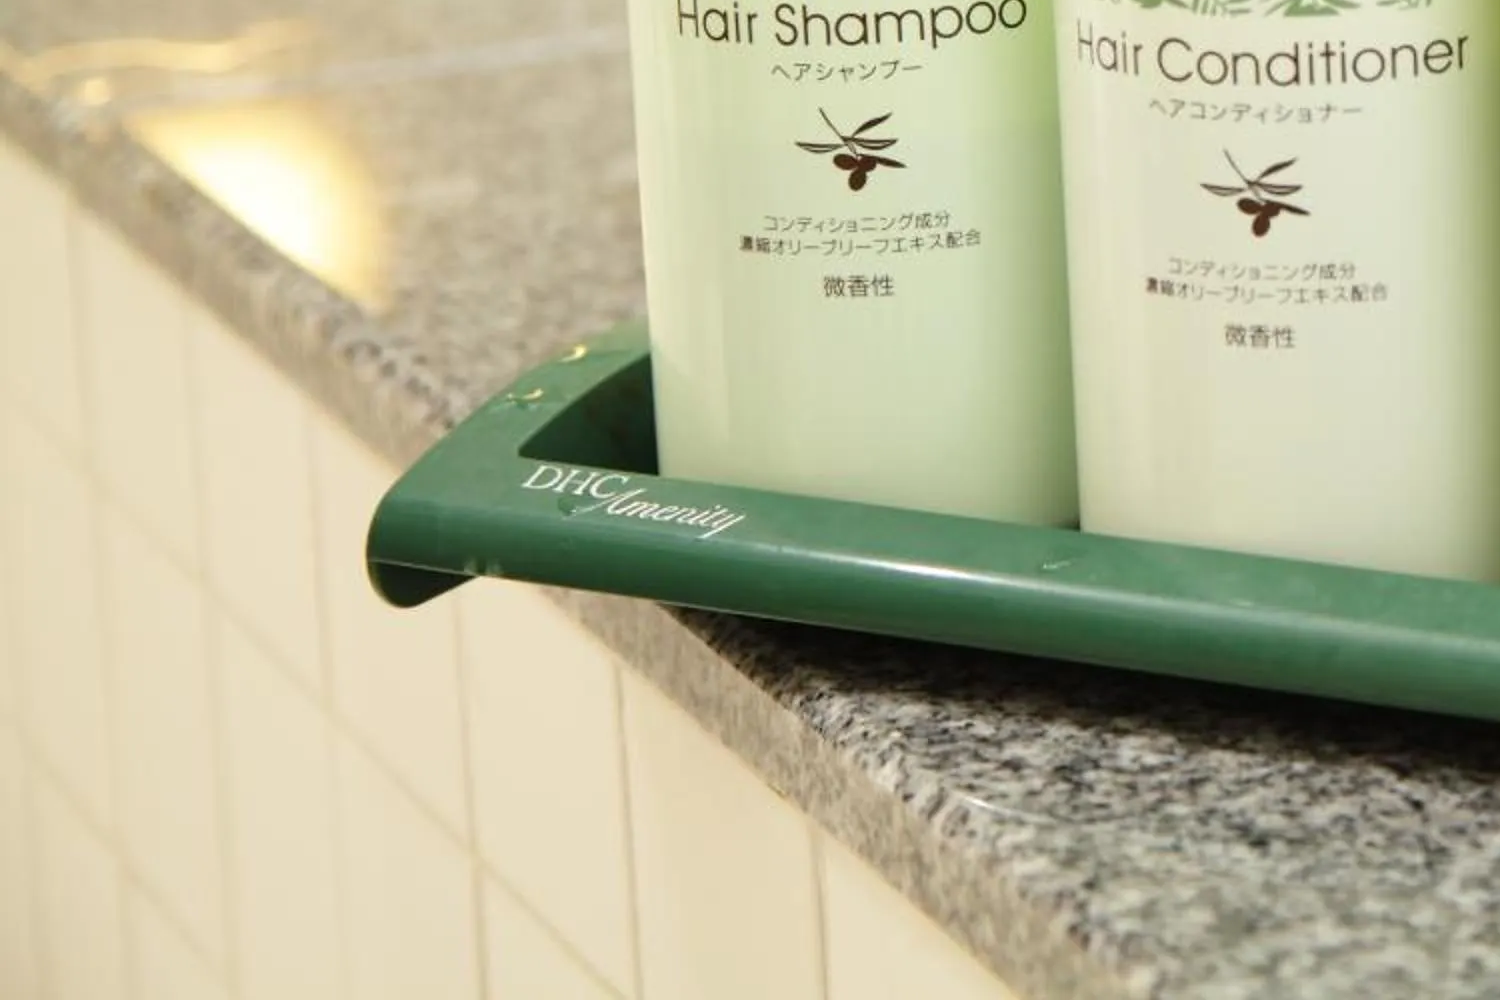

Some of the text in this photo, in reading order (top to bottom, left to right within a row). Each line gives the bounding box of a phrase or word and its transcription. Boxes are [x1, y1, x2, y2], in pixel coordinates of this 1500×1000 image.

[1076, 20, 1469, 86] Hair Conditioner
[771, 60, 922, 82] ヘアシャンプー
[1148, 99, 1362, 123] ヘアコンディショナー
[764, 211, 950, 233] コンディショニング成分
[824, 275, 895, 298] 微香性
[521, 464, 746, 539] DHC Amenity
